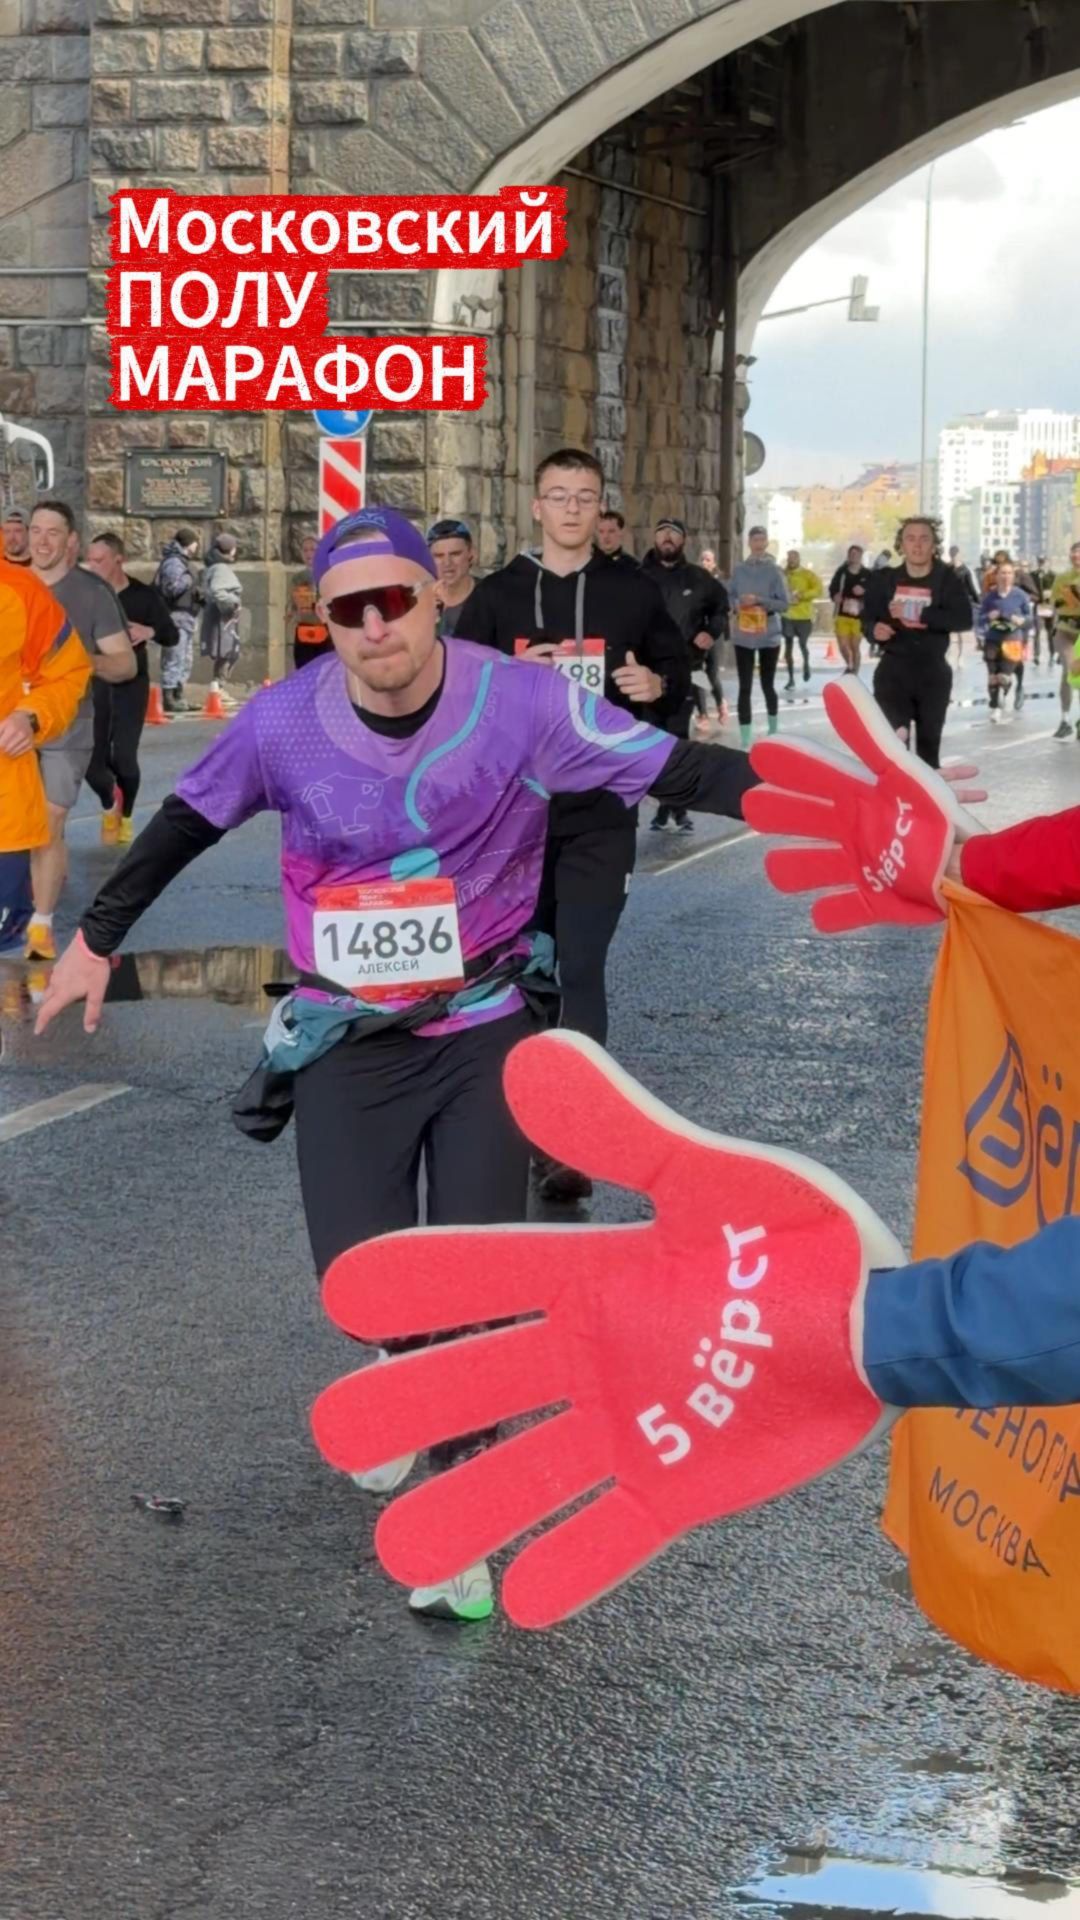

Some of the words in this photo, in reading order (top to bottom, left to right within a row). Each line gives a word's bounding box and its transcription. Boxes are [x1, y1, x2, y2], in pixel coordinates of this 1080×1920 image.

[556, 663, 601, 687] 98
[322, 916, 453, 962] 14836
[358, 958, 420, 975] АЛЕКСЕЙ
[636, 1403, 691, 1465] 5
[686, 1223, 773, 1428] вёрст
[955, 1407, 1080, 1503] ЕНОГРА
[929, 1466, 1051, 1577] МОСКВА
